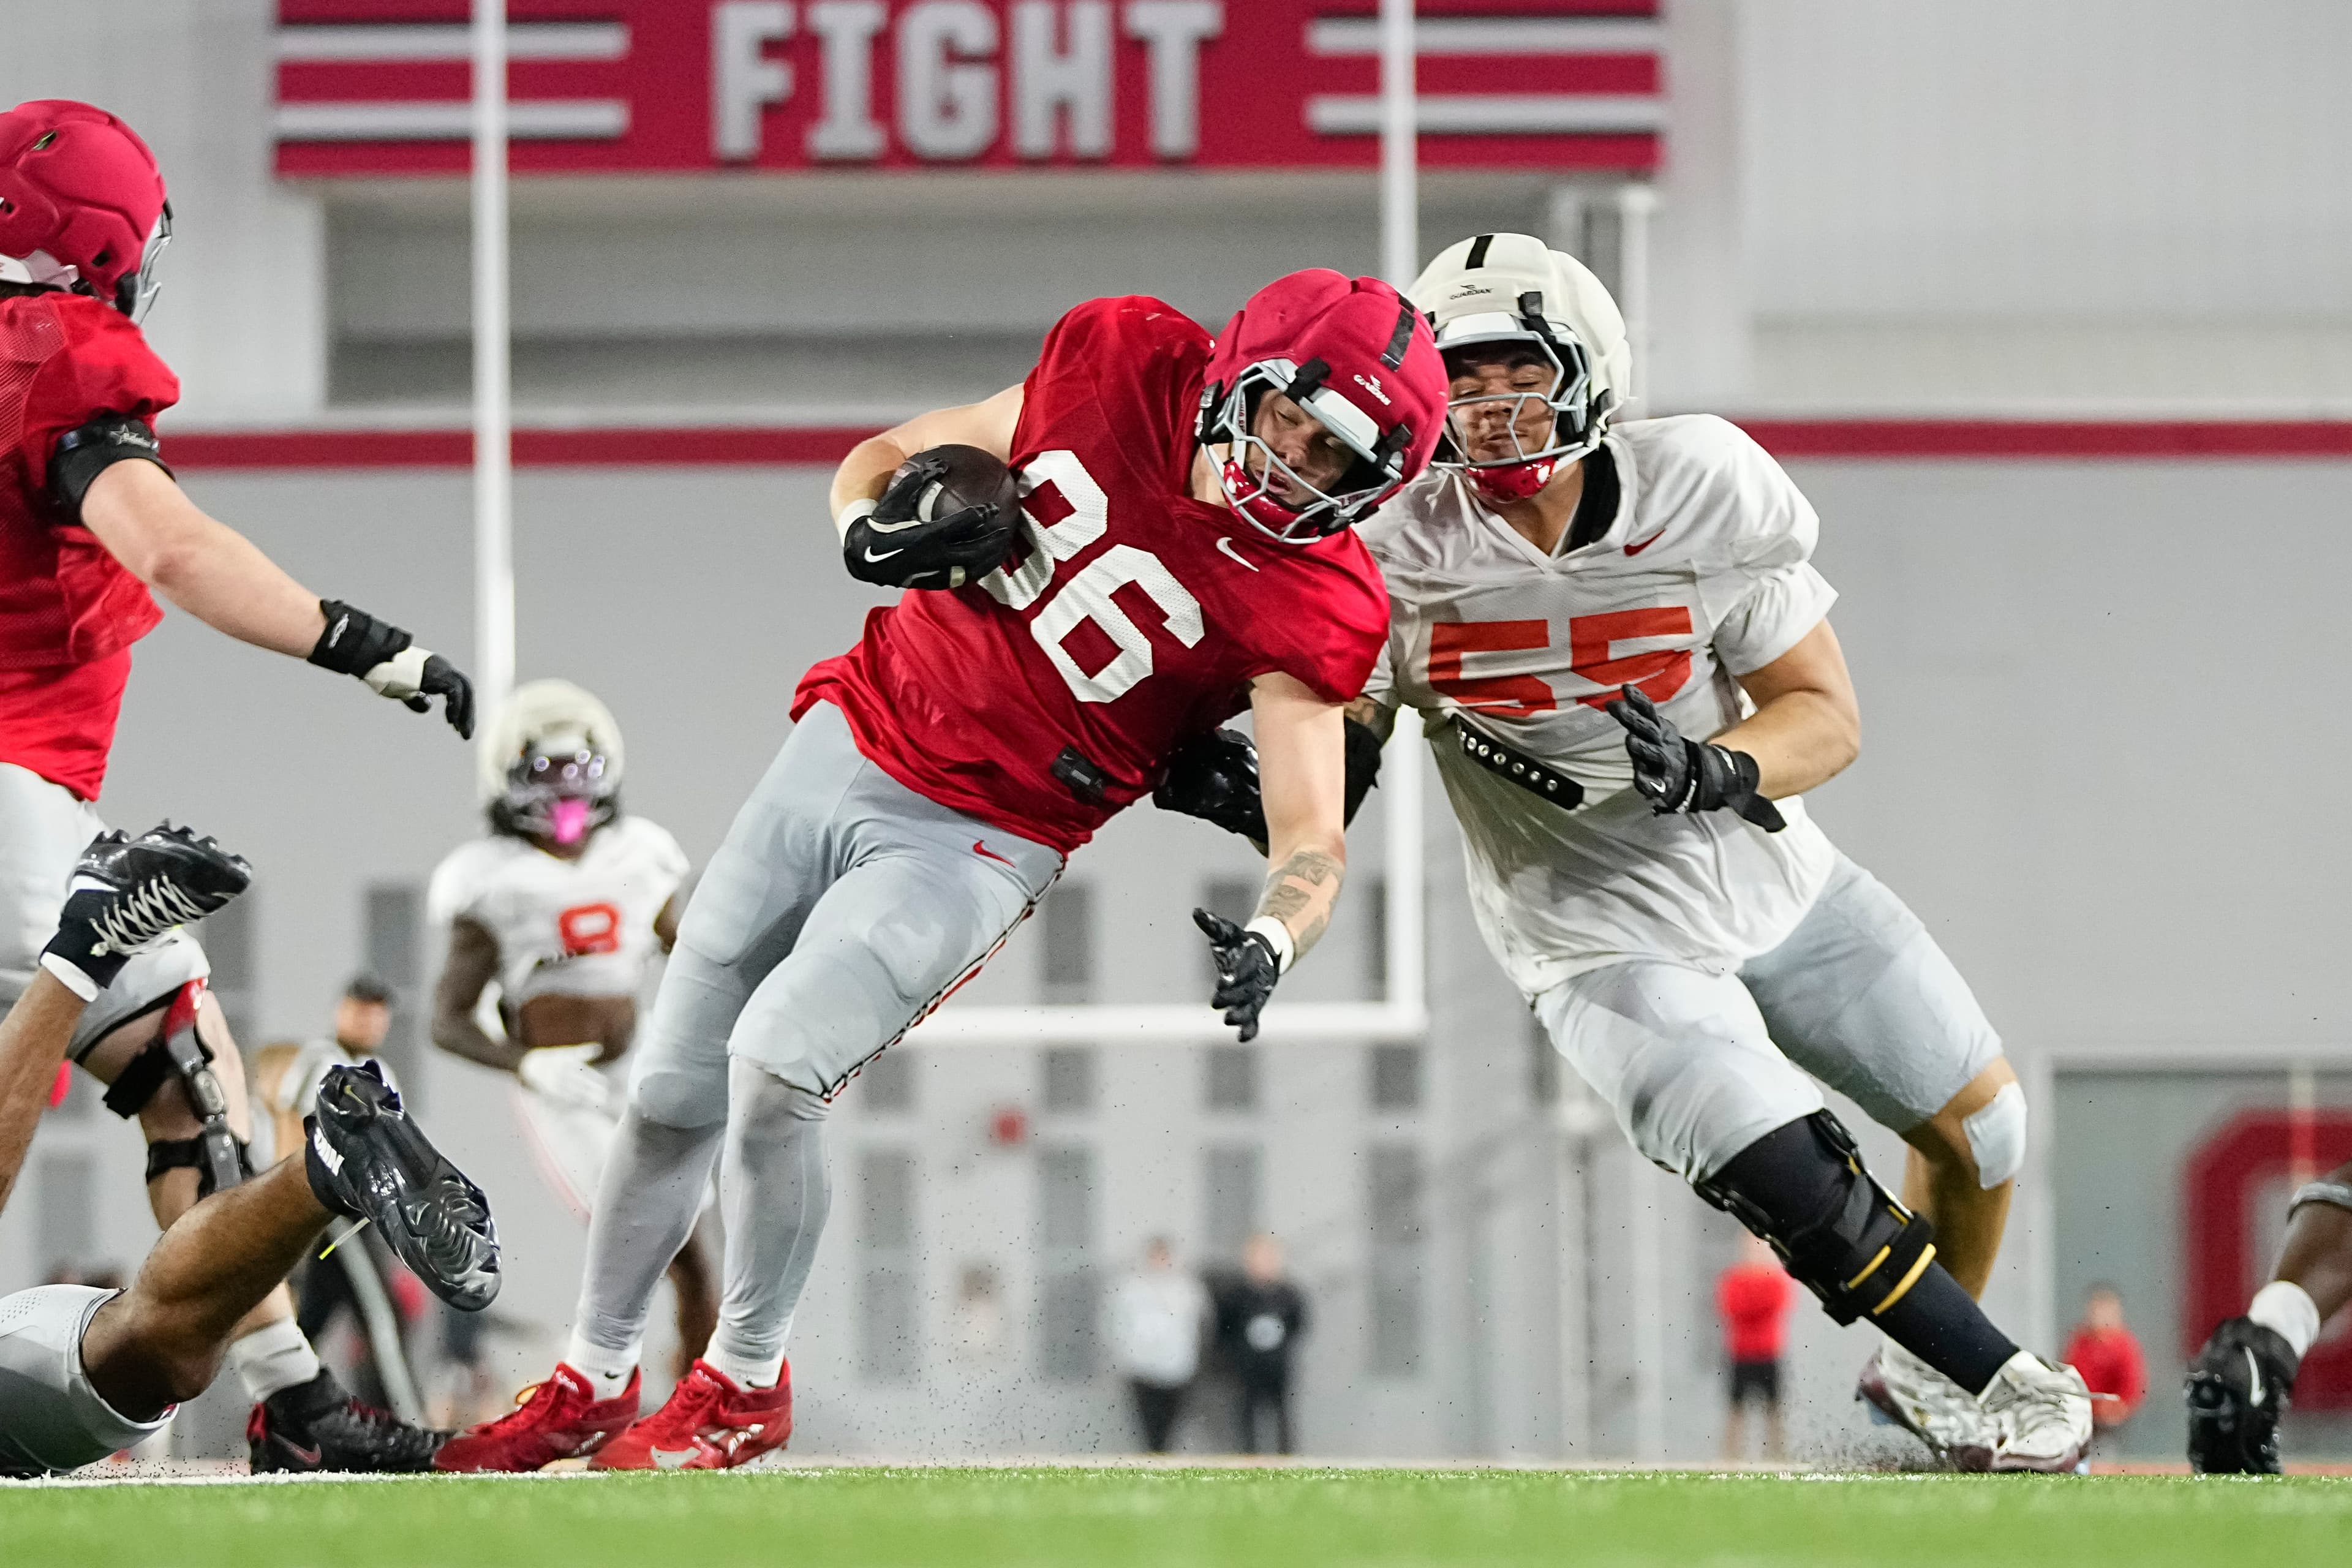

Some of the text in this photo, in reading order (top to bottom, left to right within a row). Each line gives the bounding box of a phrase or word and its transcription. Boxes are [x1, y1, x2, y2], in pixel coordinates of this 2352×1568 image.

[710, 0, 1223, 160] FIGHT
[978, 450, 1205, 704] 86
[1428, 606, 1694, 717] 55
